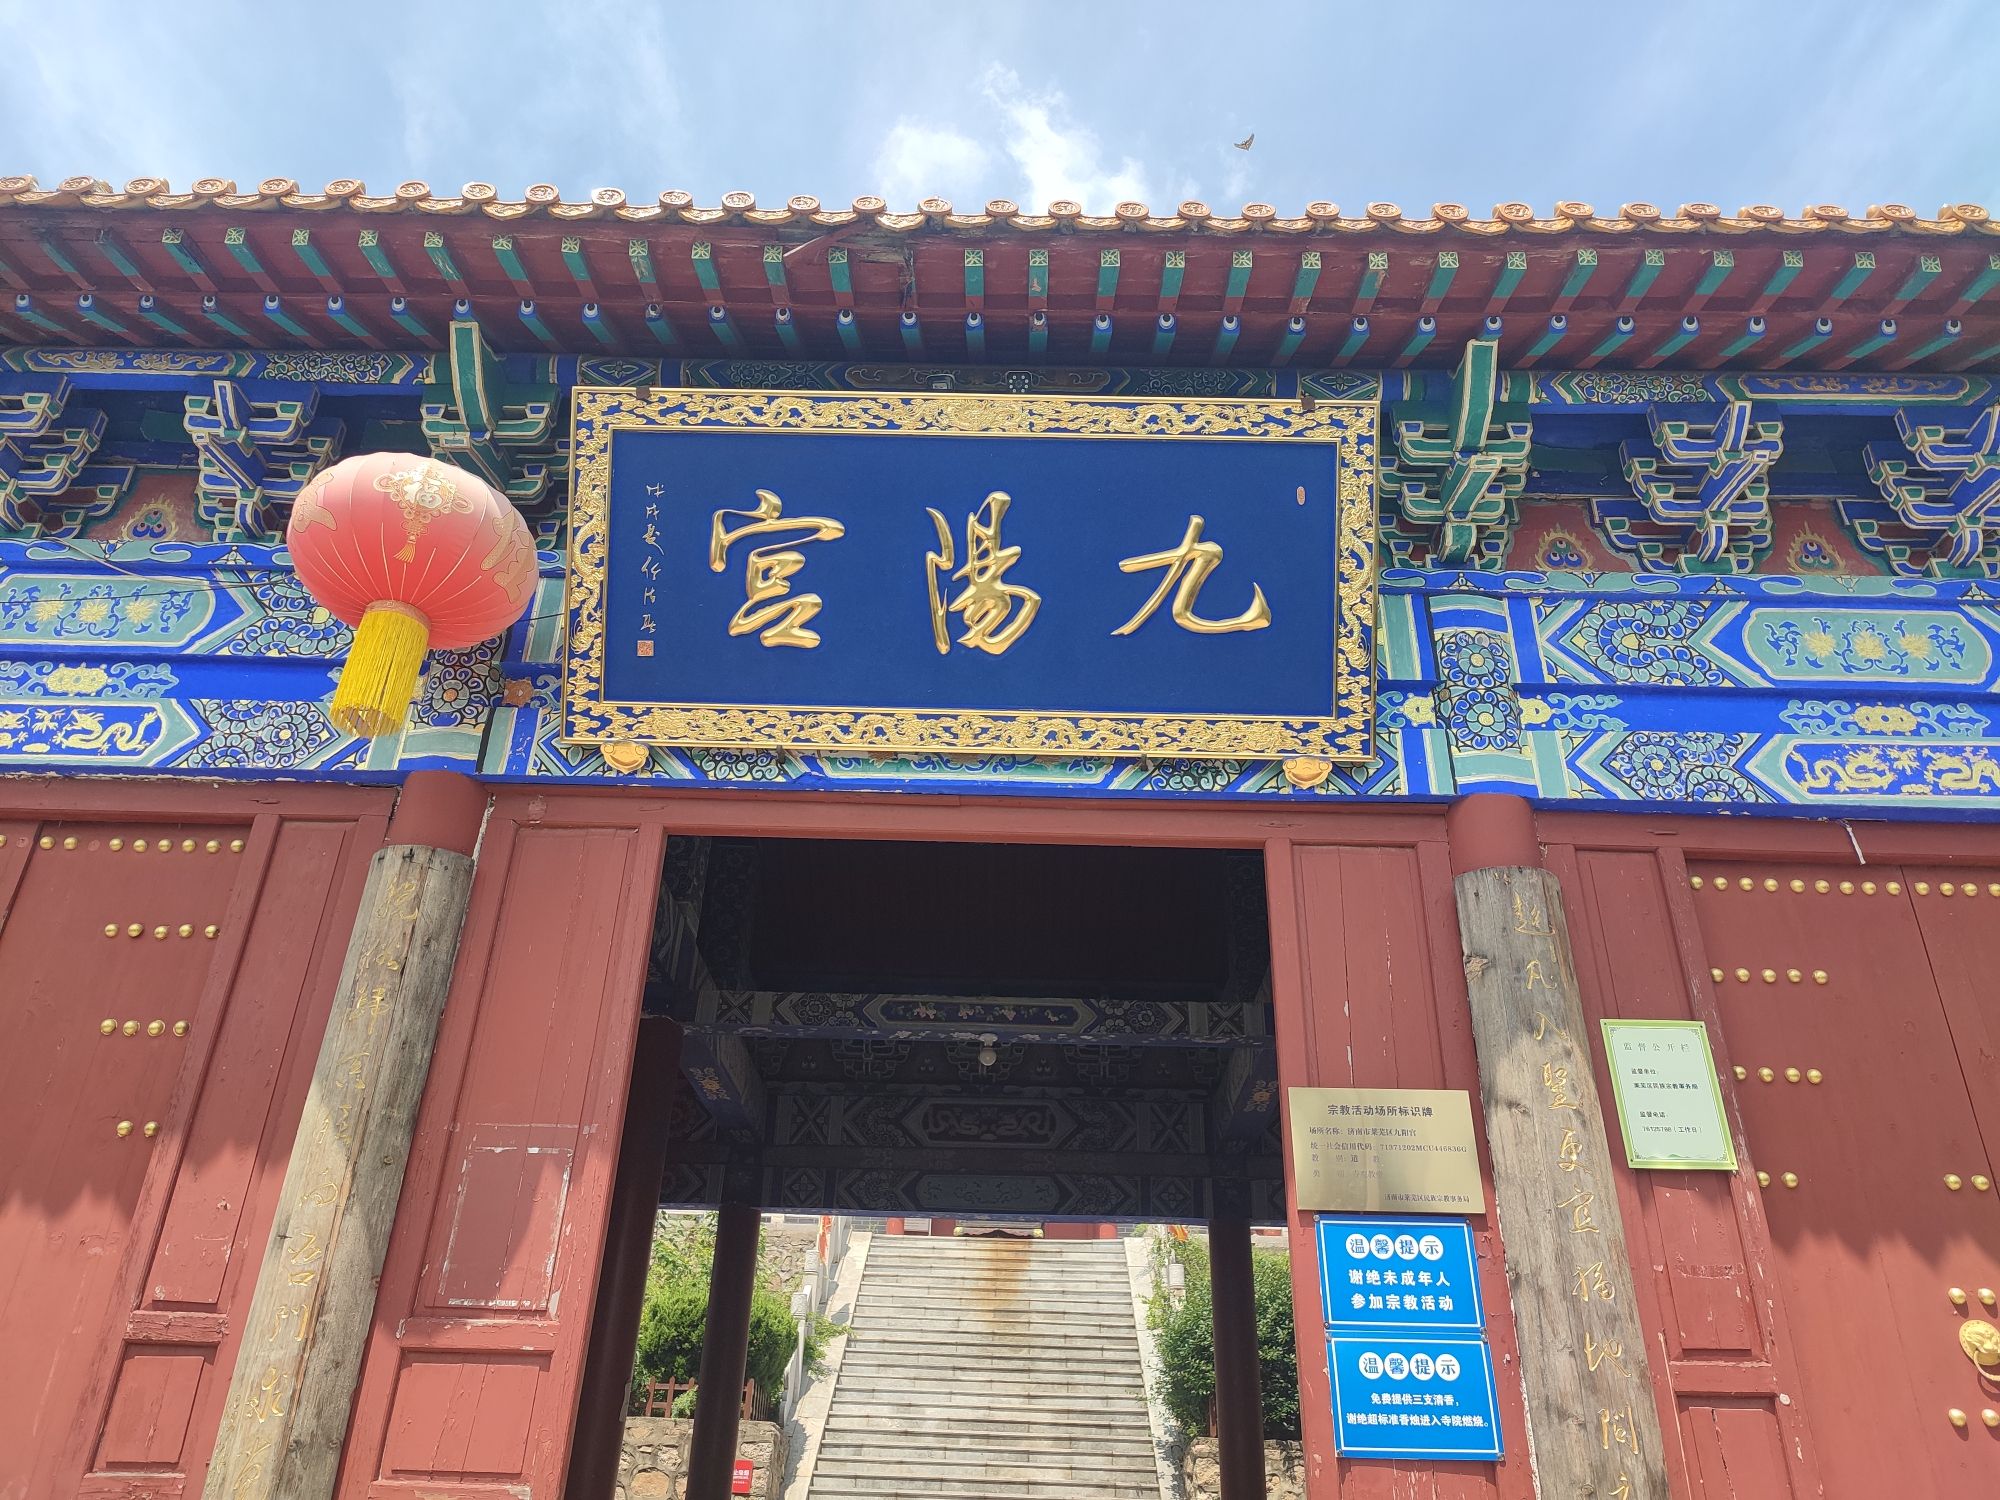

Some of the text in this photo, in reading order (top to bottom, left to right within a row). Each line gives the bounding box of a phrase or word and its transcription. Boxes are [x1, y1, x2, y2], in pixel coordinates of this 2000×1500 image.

[1623, 1042, 1690, 1052] 监督公开栏
[1327, 1104, 1434, 1118] 宗教活动场所标识牌
[1350, 1236, 1441, 1257] 温馨提示
[1349, 1268, 1451, 1287] 谢绝未成年人
[1351, 1294, 1454, 1311] 参加宗教活动
[1363, 1356, 1457, 1377] 温馨提示
[1346, 1413, 1490, 1428] 谢绝超标准香烛进入寺院燃烧。
